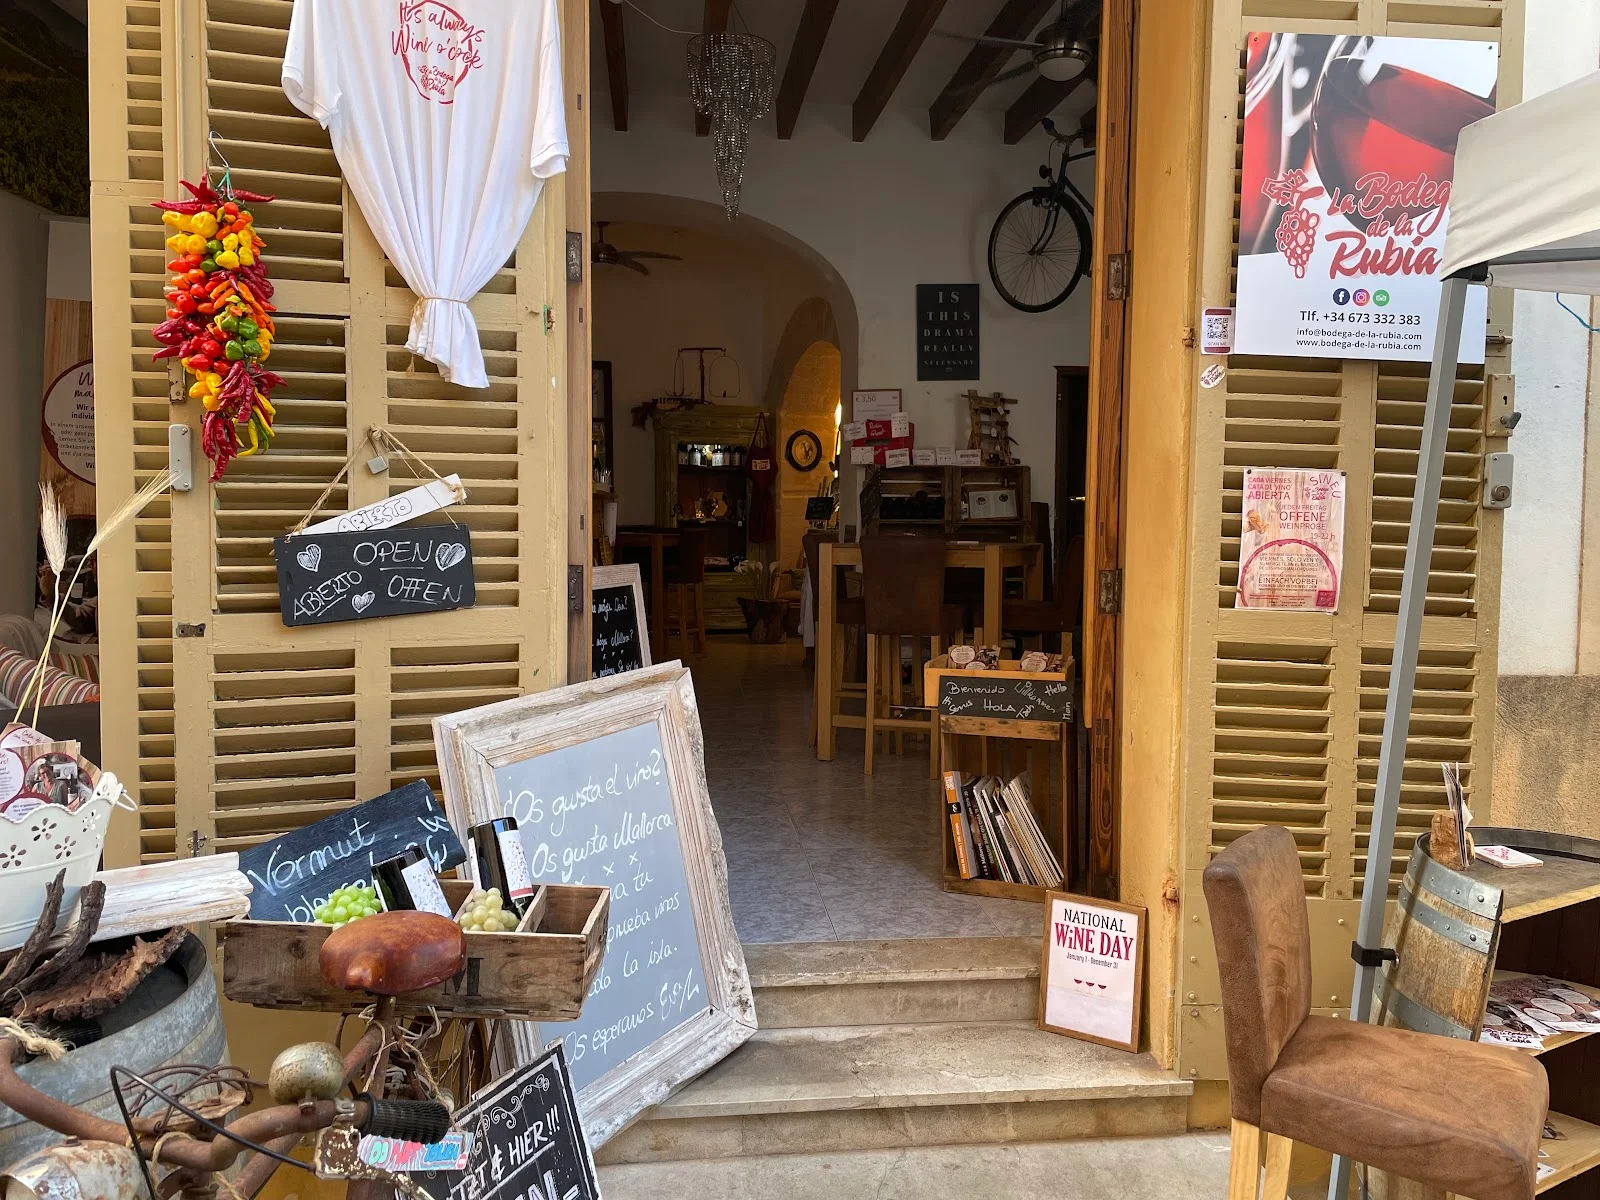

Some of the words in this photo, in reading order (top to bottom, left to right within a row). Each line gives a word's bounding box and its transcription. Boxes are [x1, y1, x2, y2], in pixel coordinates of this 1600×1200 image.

[1327, 187, 1356, 216] La
[1356, 172, 1451, 237] Bodeg
[1366, 216, 1388, 238] de
[1394, 212, 1413, 237] la
[938, 291, 959, 303] IS
[927, 311, 971, 321] THIS
[1300, 311, 1319, 321] Tlf.
[1323, 312, 1344, 323] +34
[1348, 313, 1370, 323] 673
[1374, 314, 1395, 324] 332
[1399, 314, 1421, 325] 383
[924, 328, 974, 337] DRAMA
[1297, 328, 1422, 340] info@bodega-de-la-rubia.com
[1297, 339, 1421, 350] www.bodega-de-la-rubia.com
[924, 344, 974, 352] REALLY
[1248, 492, 1290, 500] ABIERTA
[338, 497, 412, 532] ABIERTO
[1280, 512, 1326, 521] OFFENE
[353, 540, 433, 566] OPEN
[294, 571, 362, 620] ABIERTO
[388, 575, 463, 603] OFFEN
[946, 681, 1005, 695] Bienvenido
[1044, 683, 1068, 697] Hello
[983, 698, 1016, 712] HOLA
[551, 775, 604, 837] gusta
[605, 764, 622, 796] el
[626, 749, 661, 791] vino?
[247, 817, 376, 896] Vermut
[531, 843, 557, 879] Os
[562, 824, 609, 883] gusta
[613, 811, 673, 850] Mallorca
[632, 862, 653, 892] tu
[606, 908, 650, 954] prueba
[654, 892, 680, 919] vinos
[1064, 908, 1126, 933] NATIONAL
[1100, 931, 1134, 961] DAY
[1066, 952, 1085, 964] January
[1090, 957, 1110, 968] December
[592, 1002, 655, 1055] esperamos
[368, 1141, 389, 1165] DO
[389, 1141, 423, 1165] NOT
